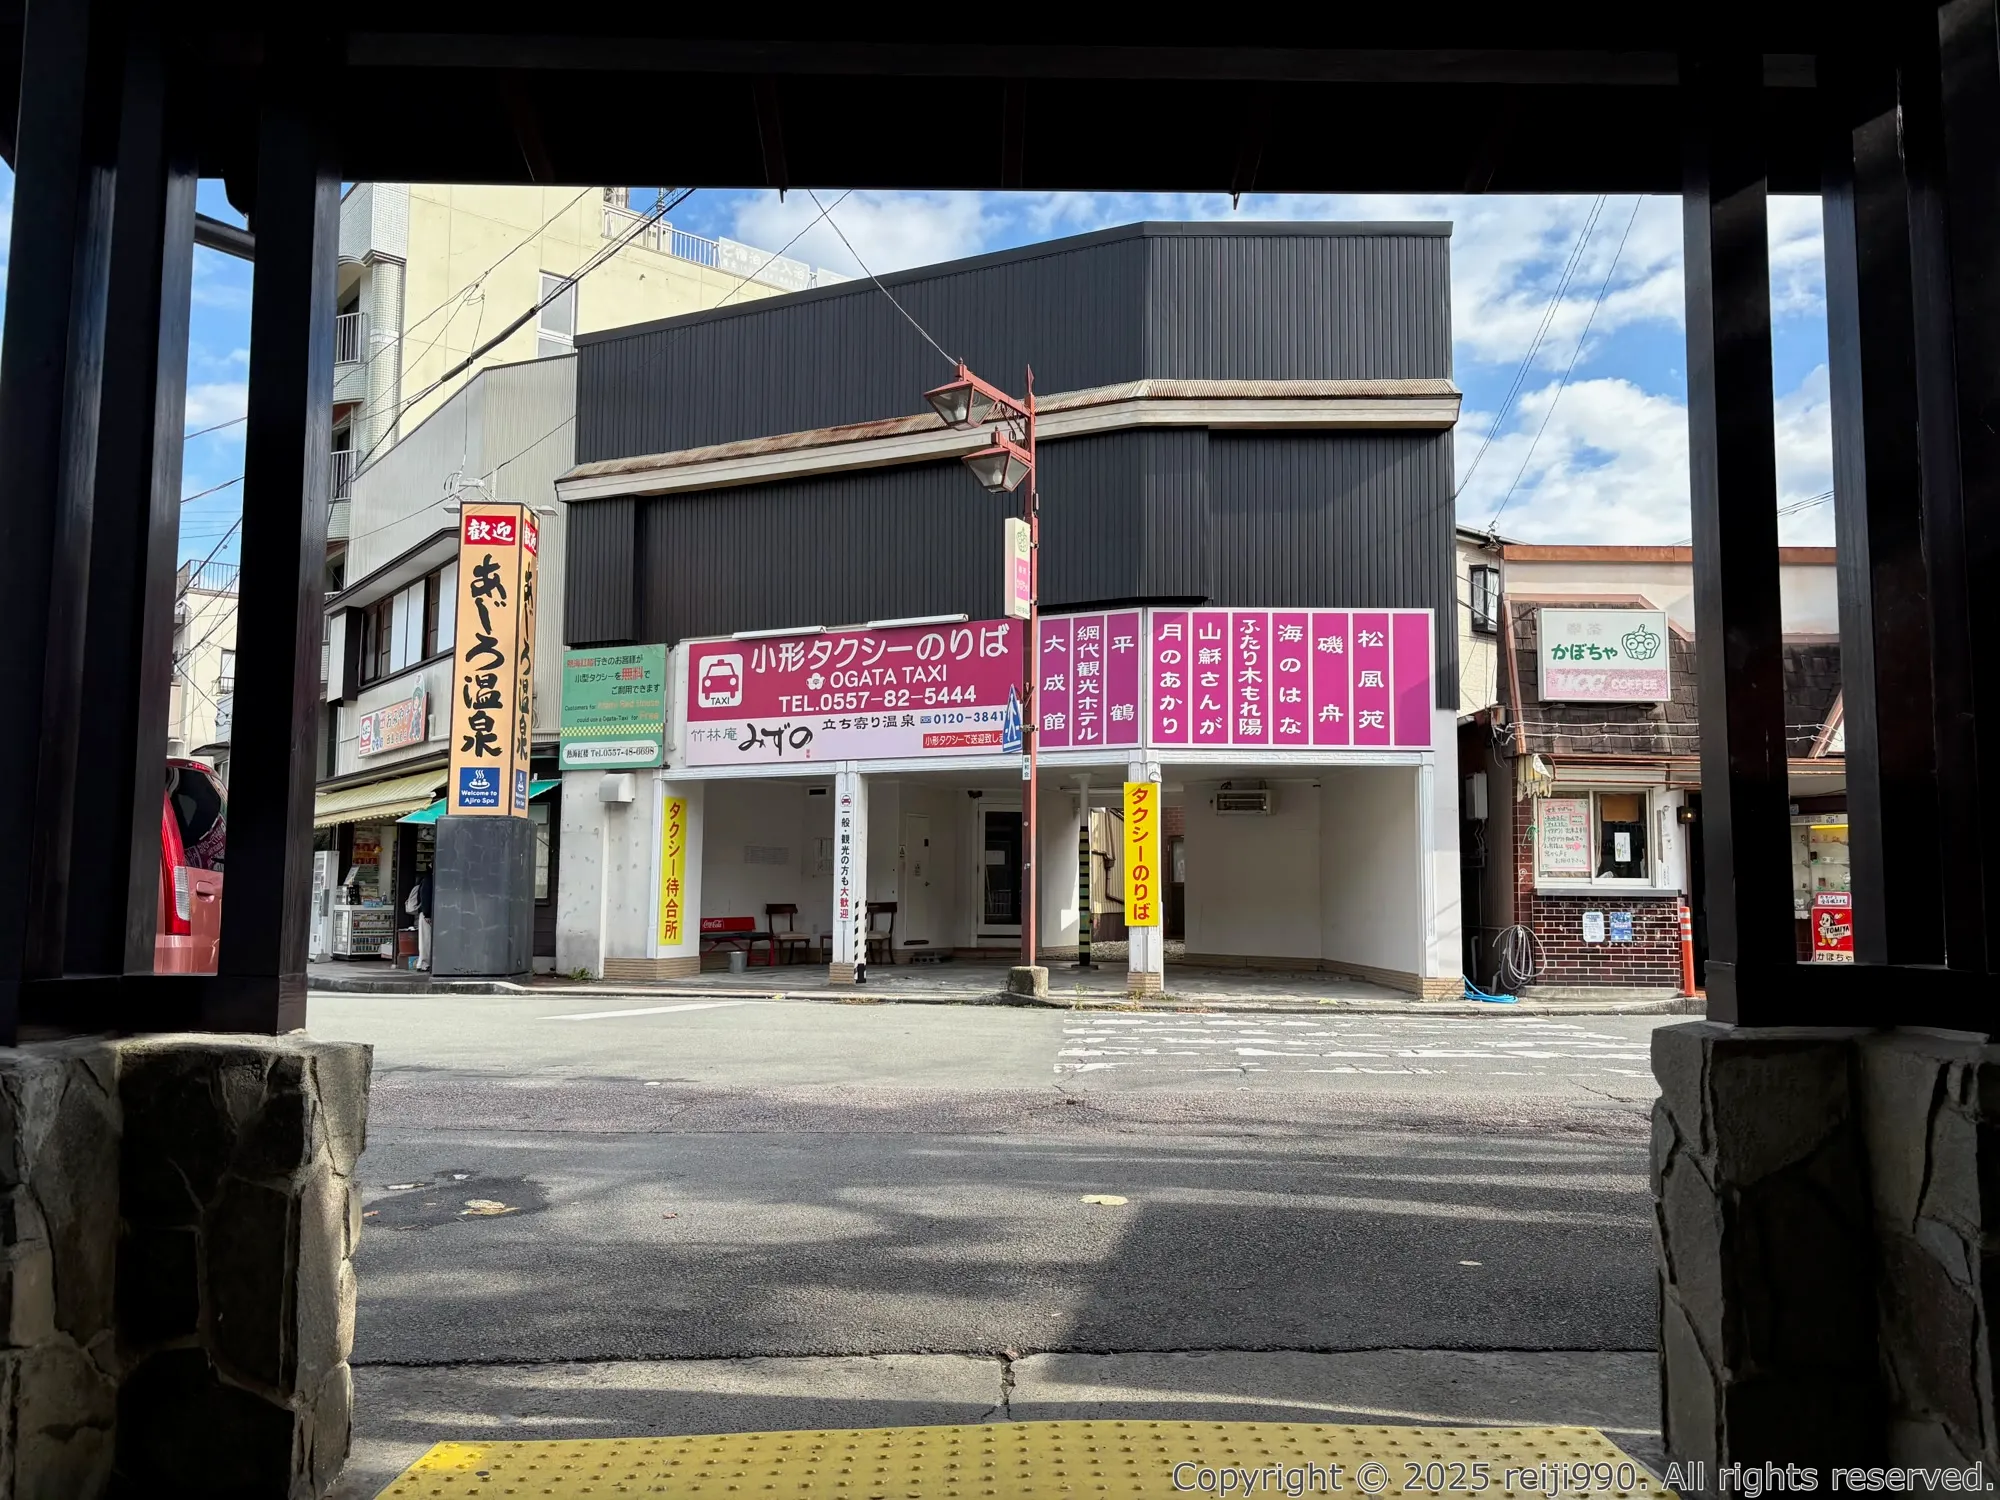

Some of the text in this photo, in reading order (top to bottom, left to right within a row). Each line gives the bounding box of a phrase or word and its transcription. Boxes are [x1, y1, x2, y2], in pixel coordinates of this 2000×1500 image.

[468, 519, 514, 541] 歓迎
[461, 553, 507, 757] あじろ温泉
[751, 623, 1010, 673] 小形タクシーのりば
[830, 664, 947, 688] OGATA TAXI
[1043, 635, 1066, 731] 大成館
[1077, 625, 1100, 740] 網代観光ホテル
[1110, 635, 1135, 722] 平鶴
[1158, 624, 1183, 734] 月のあかり
[1238, 619, 1262, 735] ふたり木もれ陽
[1277, 624, 1303, 734] 海のはな
[1317, 635, 1344, 722] 磯舟
[1357, 630, 1385, 729] 松風苑
[1551, 643, 1618, 661] かぼちゃ
[691, 722, 813, 756] 竹林庵 みずの
[711, 697, 730, 705] TAXI
[778, 685, 976, 713] TEL.0557-82-5444
[822, 714, 916, 730] 立ち寄り温泉
[933, 710, 1006, 725] 0120-3841
[664, 802, 681, 940] タクシー待合所
[839, 810, 851, 919] 一般・観光の方も大歓迎
[1132, 788, 1151, 920] タクシーのりば
[1816, 951, 1853, 962] かぼちゃ
[1826, 924, 1850, 935] TOMIYA
